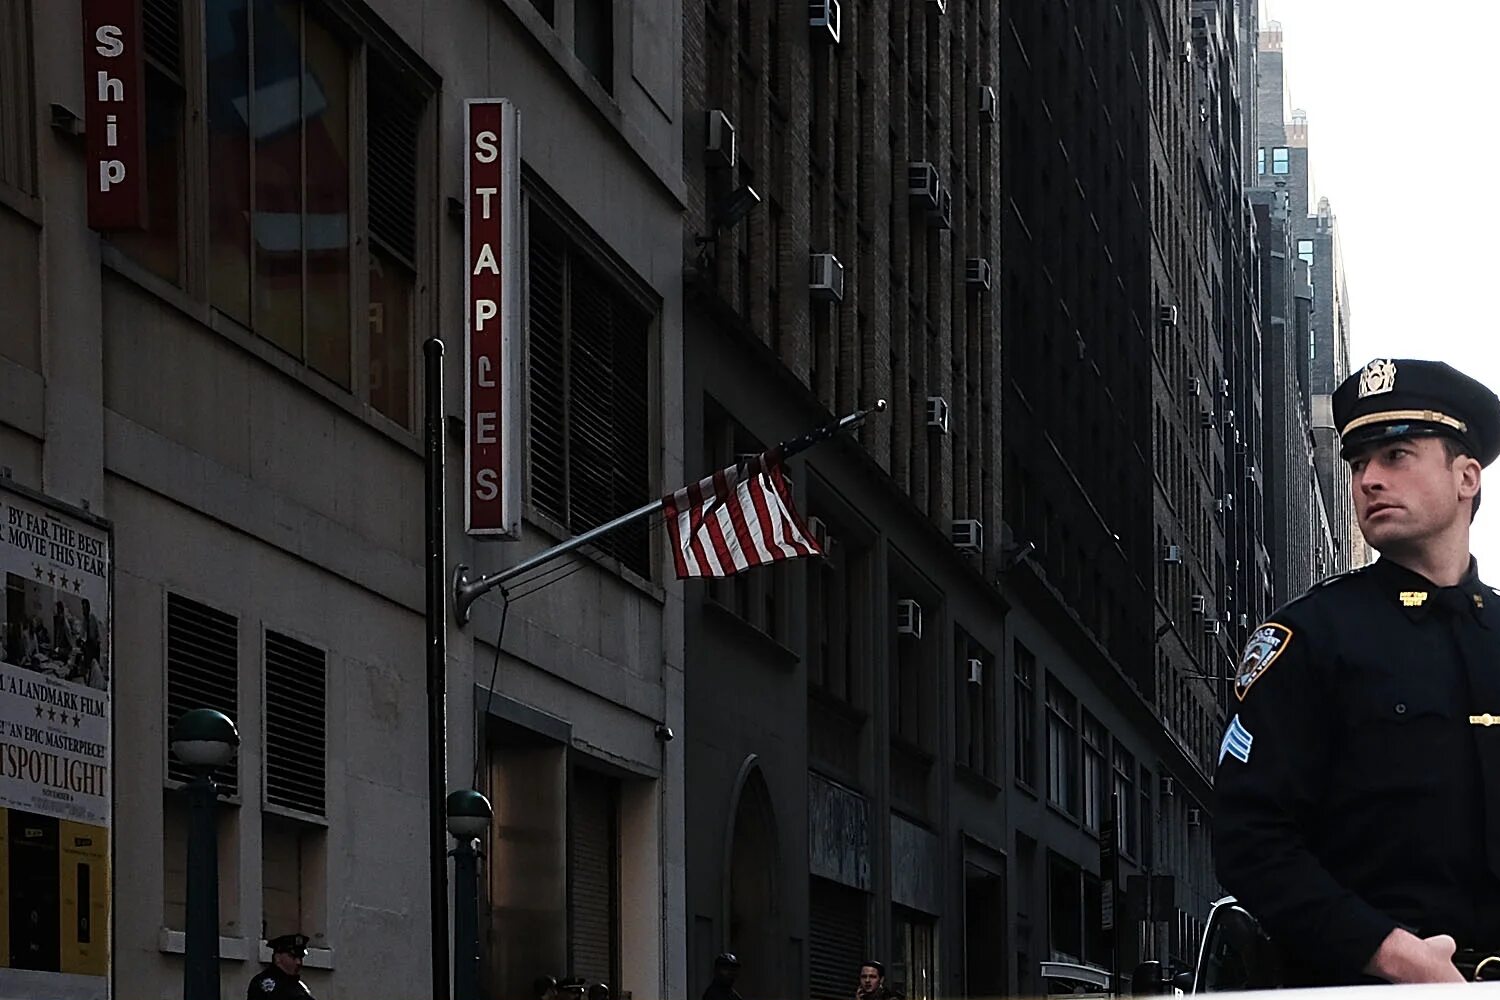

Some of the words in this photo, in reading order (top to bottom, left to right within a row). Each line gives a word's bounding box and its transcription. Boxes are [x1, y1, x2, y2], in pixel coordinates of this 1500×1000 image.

[95, 24, 126, 193] Ship
[472, 130, 499, 501] STAPLES
[8, 526, 47, 556] MOVIE
[48, 541, 75, 567] THIS
[76, 551, 106, 578] YEAR
[9, 506, 24, 528] BY
[26, 513, 50, 539] FAR
[51, 522, 76, 548] THE
[78, 533, 105, 558] BEST
[19, 678, 78, 711] LANDMARK
[24, 726, 44, 745] EPIC
[8, 743, 107, 797] SPOTLIGHT
